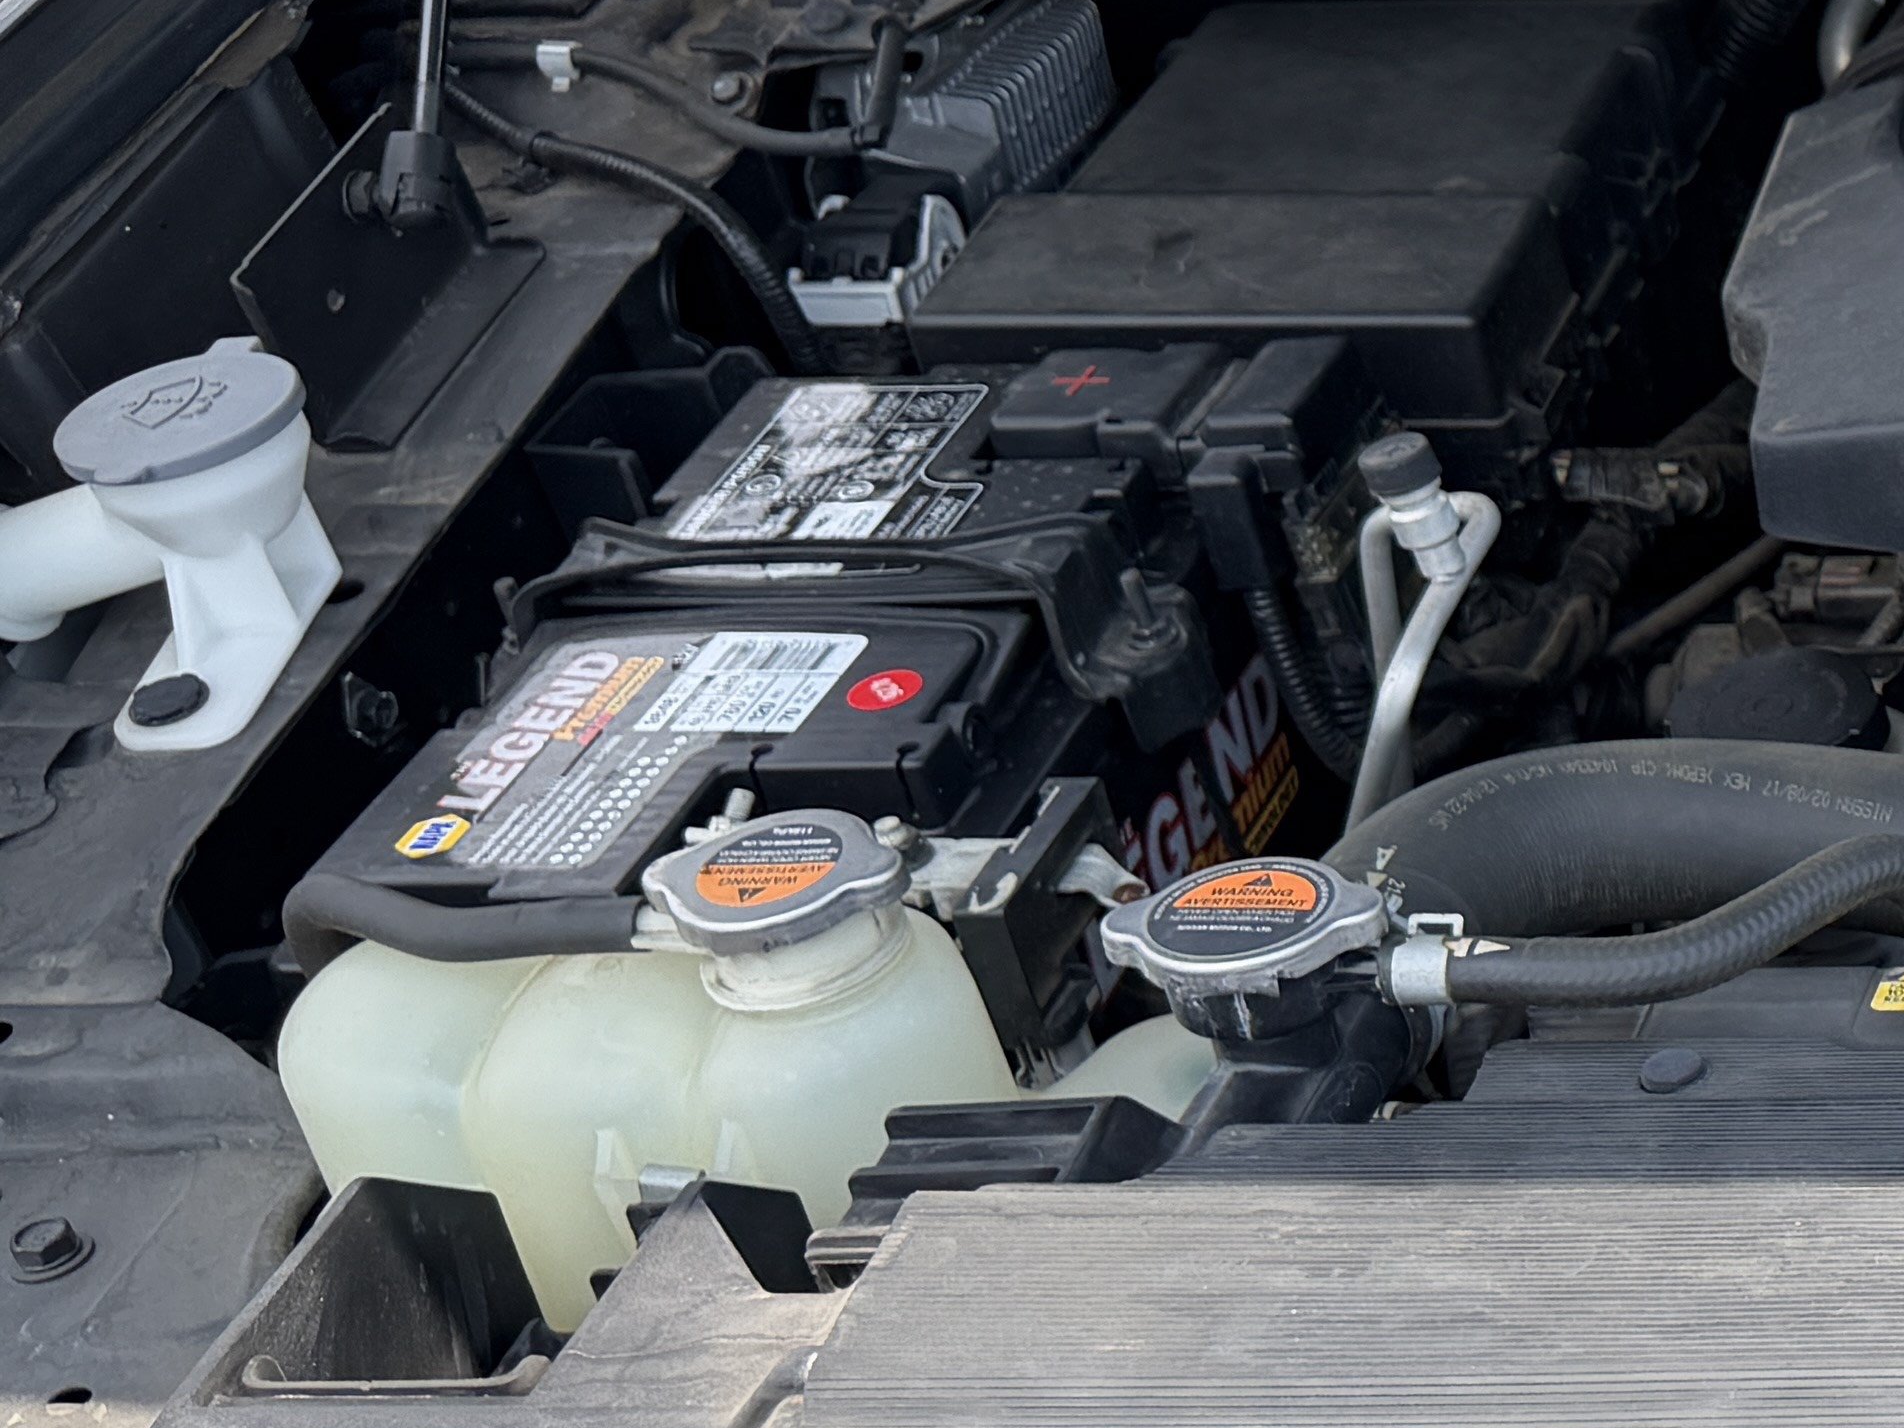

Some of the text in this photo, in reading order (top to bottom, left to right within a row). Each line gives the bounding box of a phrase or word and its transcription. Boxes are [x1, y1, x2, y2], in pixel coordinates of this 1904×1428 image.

[435, 650, 621, 813] LEGEND
[1834, 794, 1895, 824] NISSAN
[717, 875, 799, 887] WARNING
[1211, 886, 1295, 897] WARNING
[1182, 897, 1308, 908] AVERTISSEMENT
